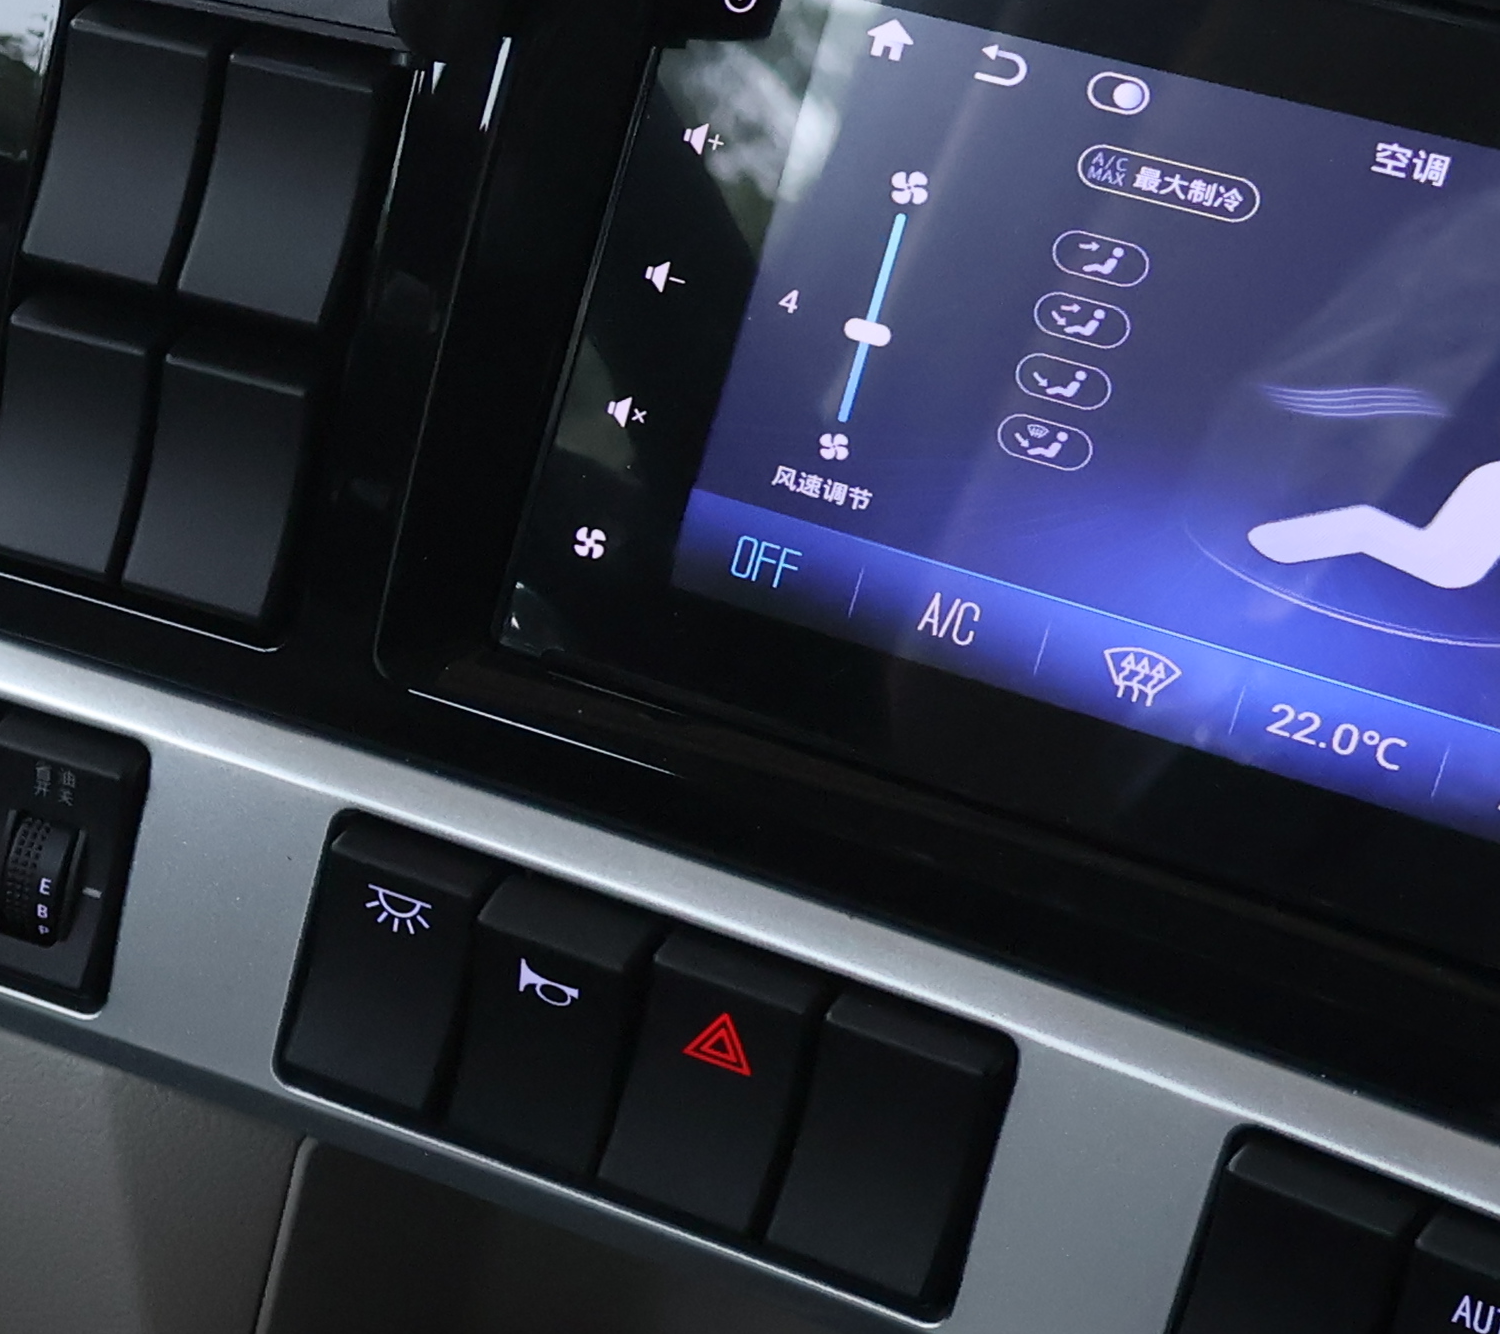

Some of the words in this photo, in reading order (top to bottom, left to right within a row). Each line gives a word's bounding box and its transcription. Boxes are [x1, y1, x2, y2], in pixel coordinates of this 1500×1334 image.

[1087, 167, 1127, 187] MAX
[1091, 151, 1130, 172] A/C
[1370, 141, 1452, 189] 空调
[1132, 165, 1244, 213] 最大制冷
[779, 288, 799, 315] 4
[771, 465, 873, 512] 风速调节
[730, 536, 802, 589] OFF
[916, 593, 980, 648] A/C
[38, 876, 52, 897] E
